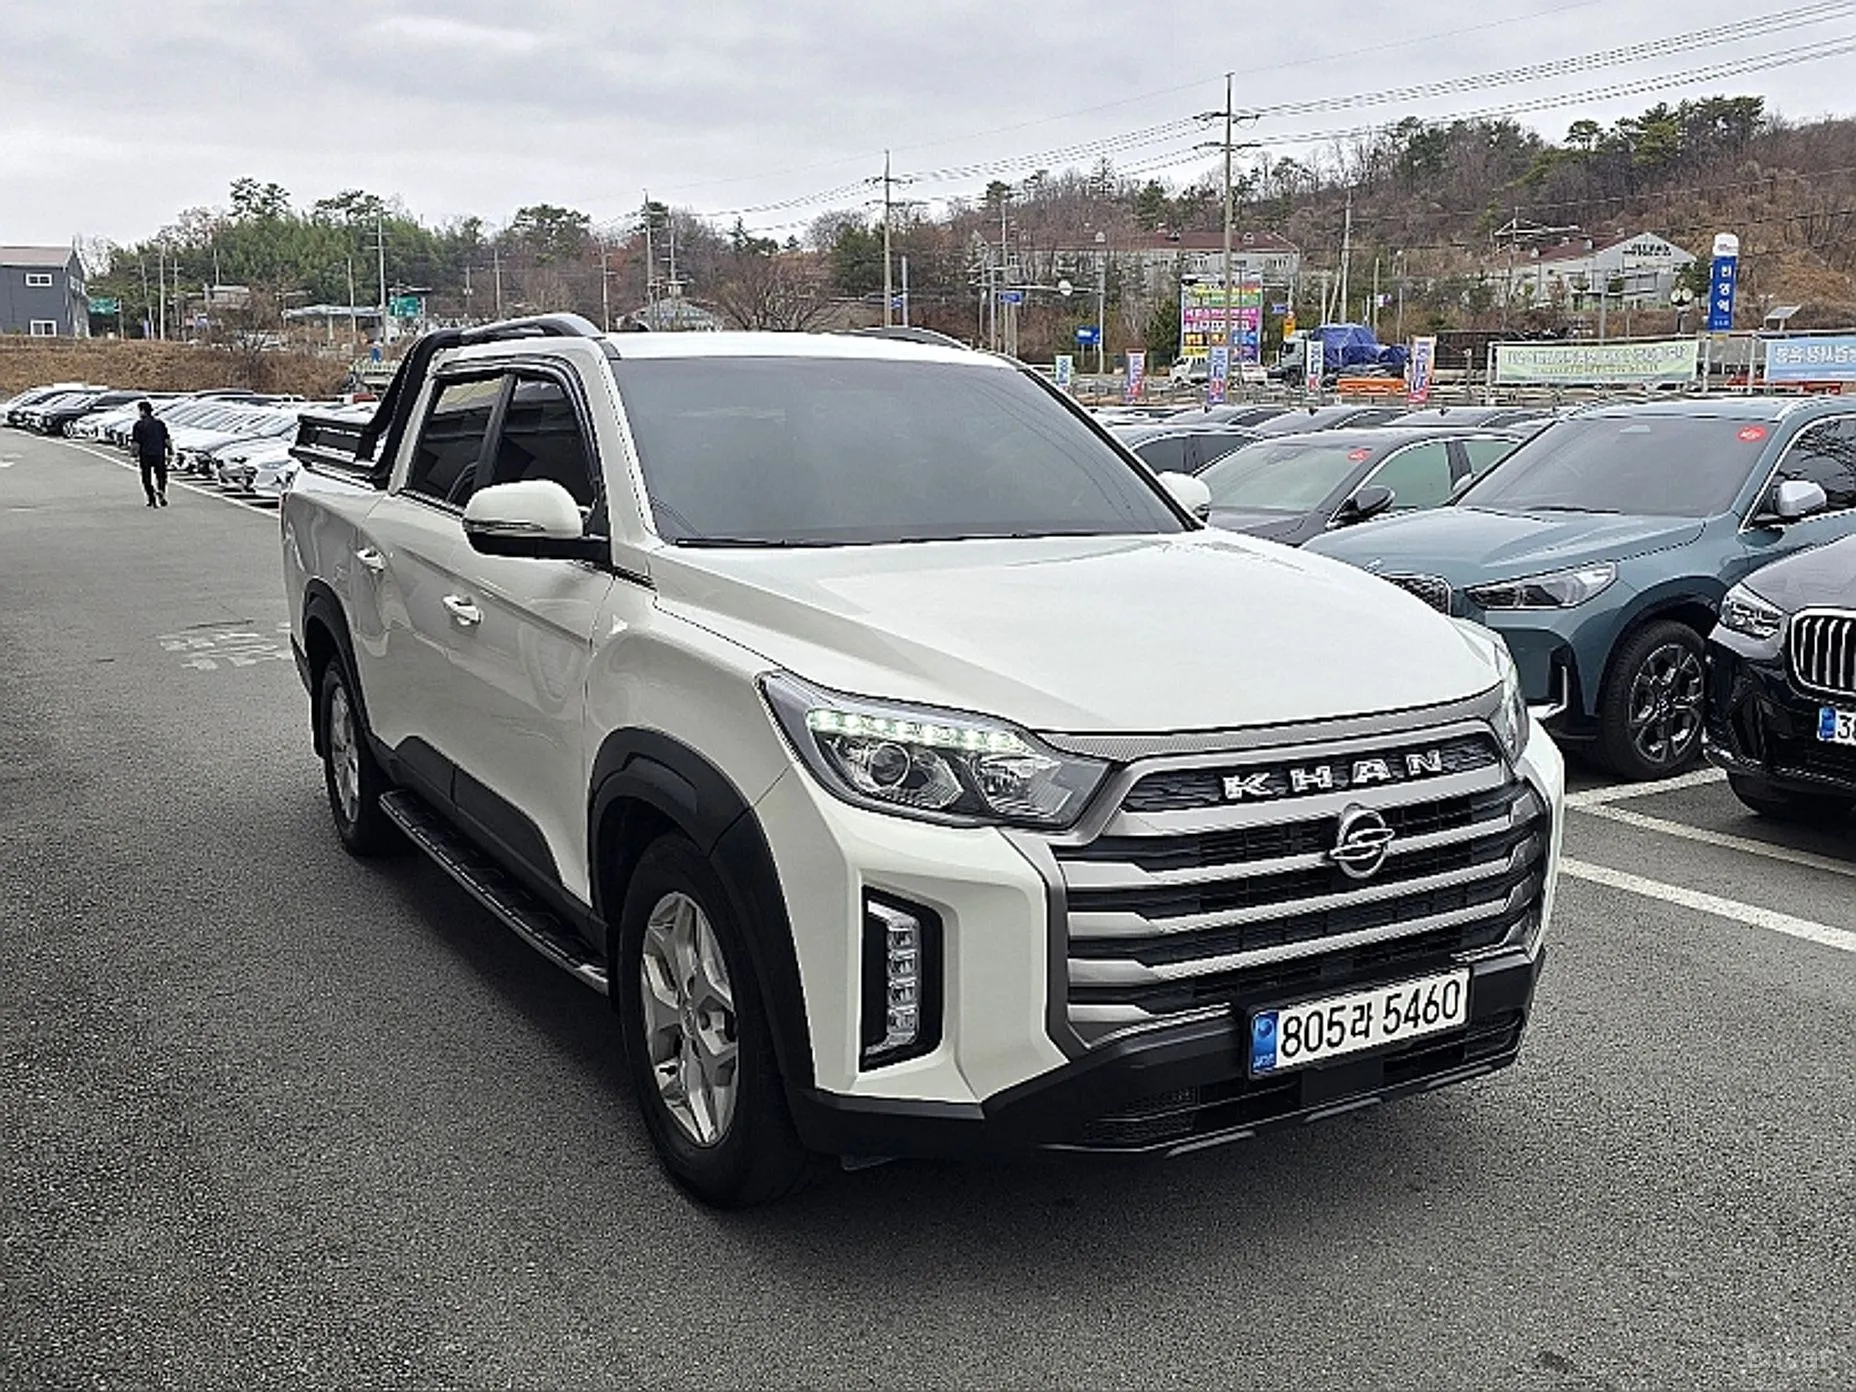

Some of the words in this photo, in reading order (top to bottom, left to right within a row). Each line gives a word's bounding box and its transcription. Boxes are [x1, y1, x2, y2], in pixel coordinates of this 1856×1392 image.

[1223, 750, 1442, 799] KHAN
[1281, 1002, 1373, 1057] 805라
[1383, 979, 1460, 1034] 5460
